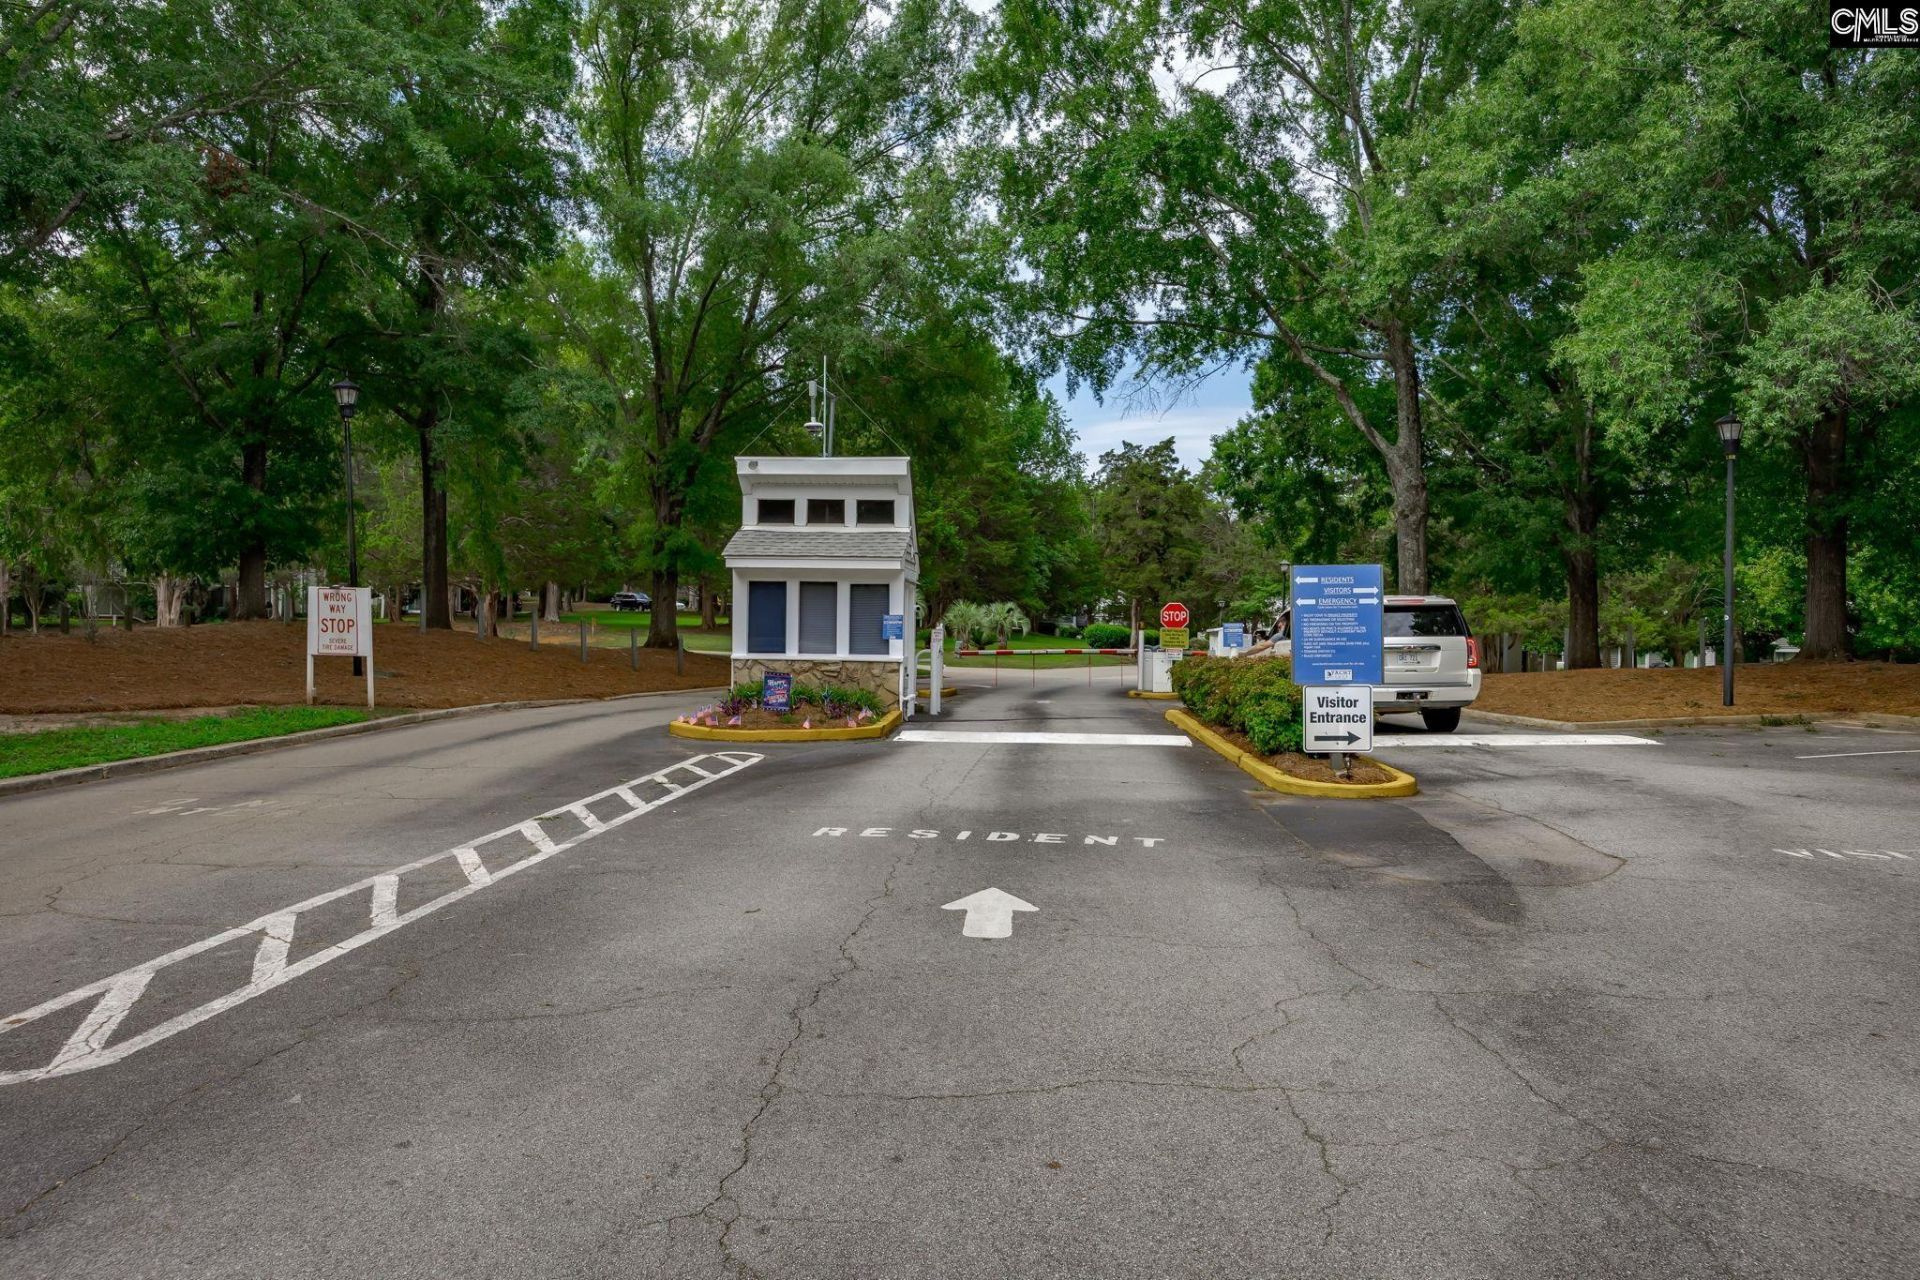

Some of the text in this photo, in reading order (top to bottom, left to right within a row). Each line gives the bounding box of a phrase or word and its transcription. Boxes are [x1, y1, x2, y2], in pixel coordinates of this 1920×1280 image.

[323, 592, 352, 602] WRONG
[329, 604, 346, 614] WAY
[1163, 611, 1186, 621] STOP
[320, 618, 355, 634] STOP
[1317, 696, 1359, 708] Visitor
[1310, 711, 1367, 723] Entrance
[812, 827, 1166, 848] RESIDENT
